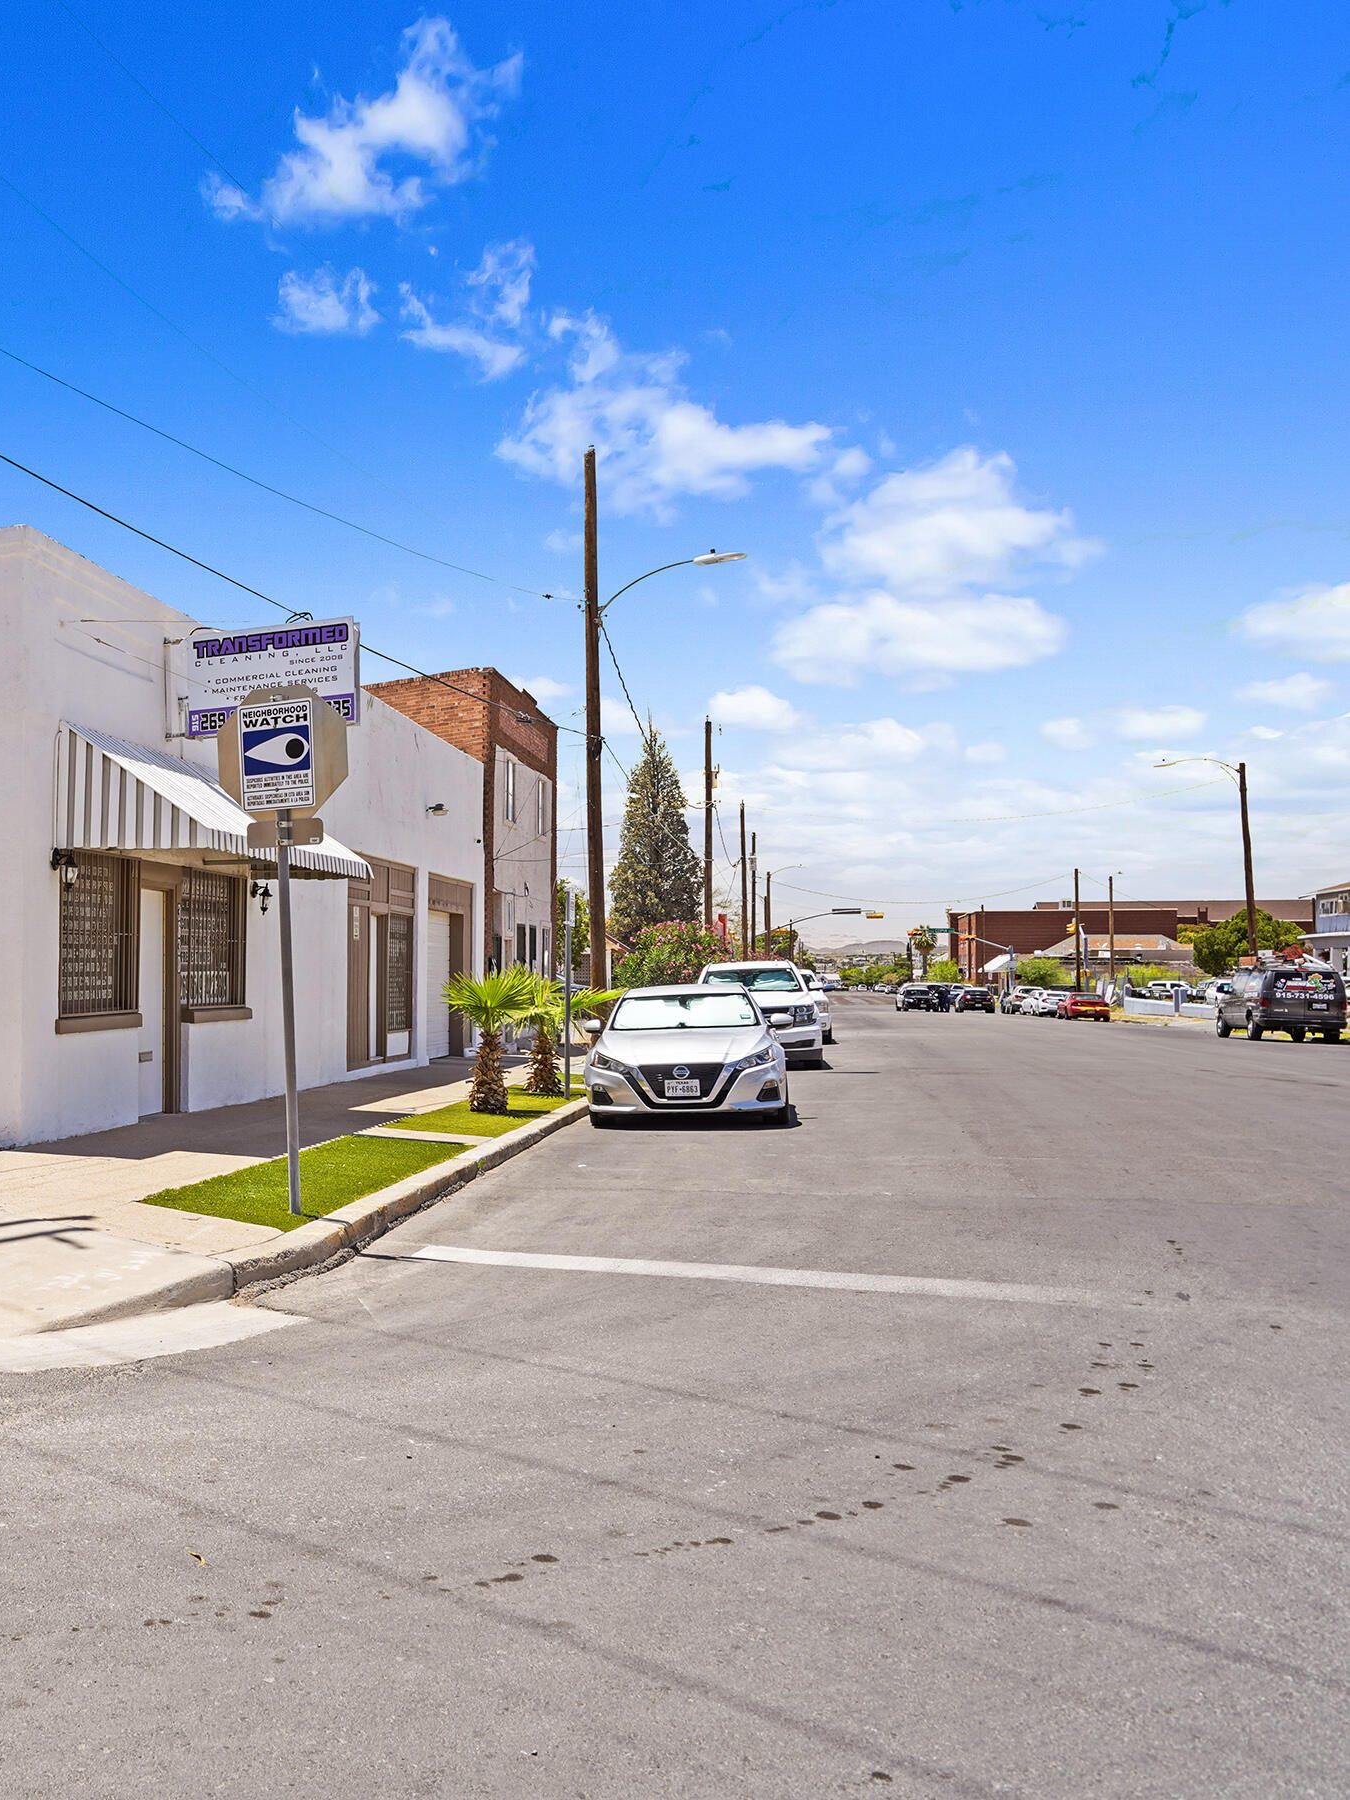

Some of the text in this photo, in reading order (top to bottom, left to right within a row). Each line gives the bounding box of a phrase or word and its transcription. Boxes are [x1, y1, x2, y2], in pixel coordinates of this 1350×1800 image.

[194, 623, 348, 659] TRANSFORMED
[315, 644, 348, 653] LLC
[290, 657, 316, 665] SINCE
[215, 665, 338, 685] COMMERCIAL CLEANING
[212, 675, 338, 694] MAINTENANCE SERVICES
[242, 704, 308, 719] NEIGHBORHOOD
[243, 713, 308, 728] WATCH
